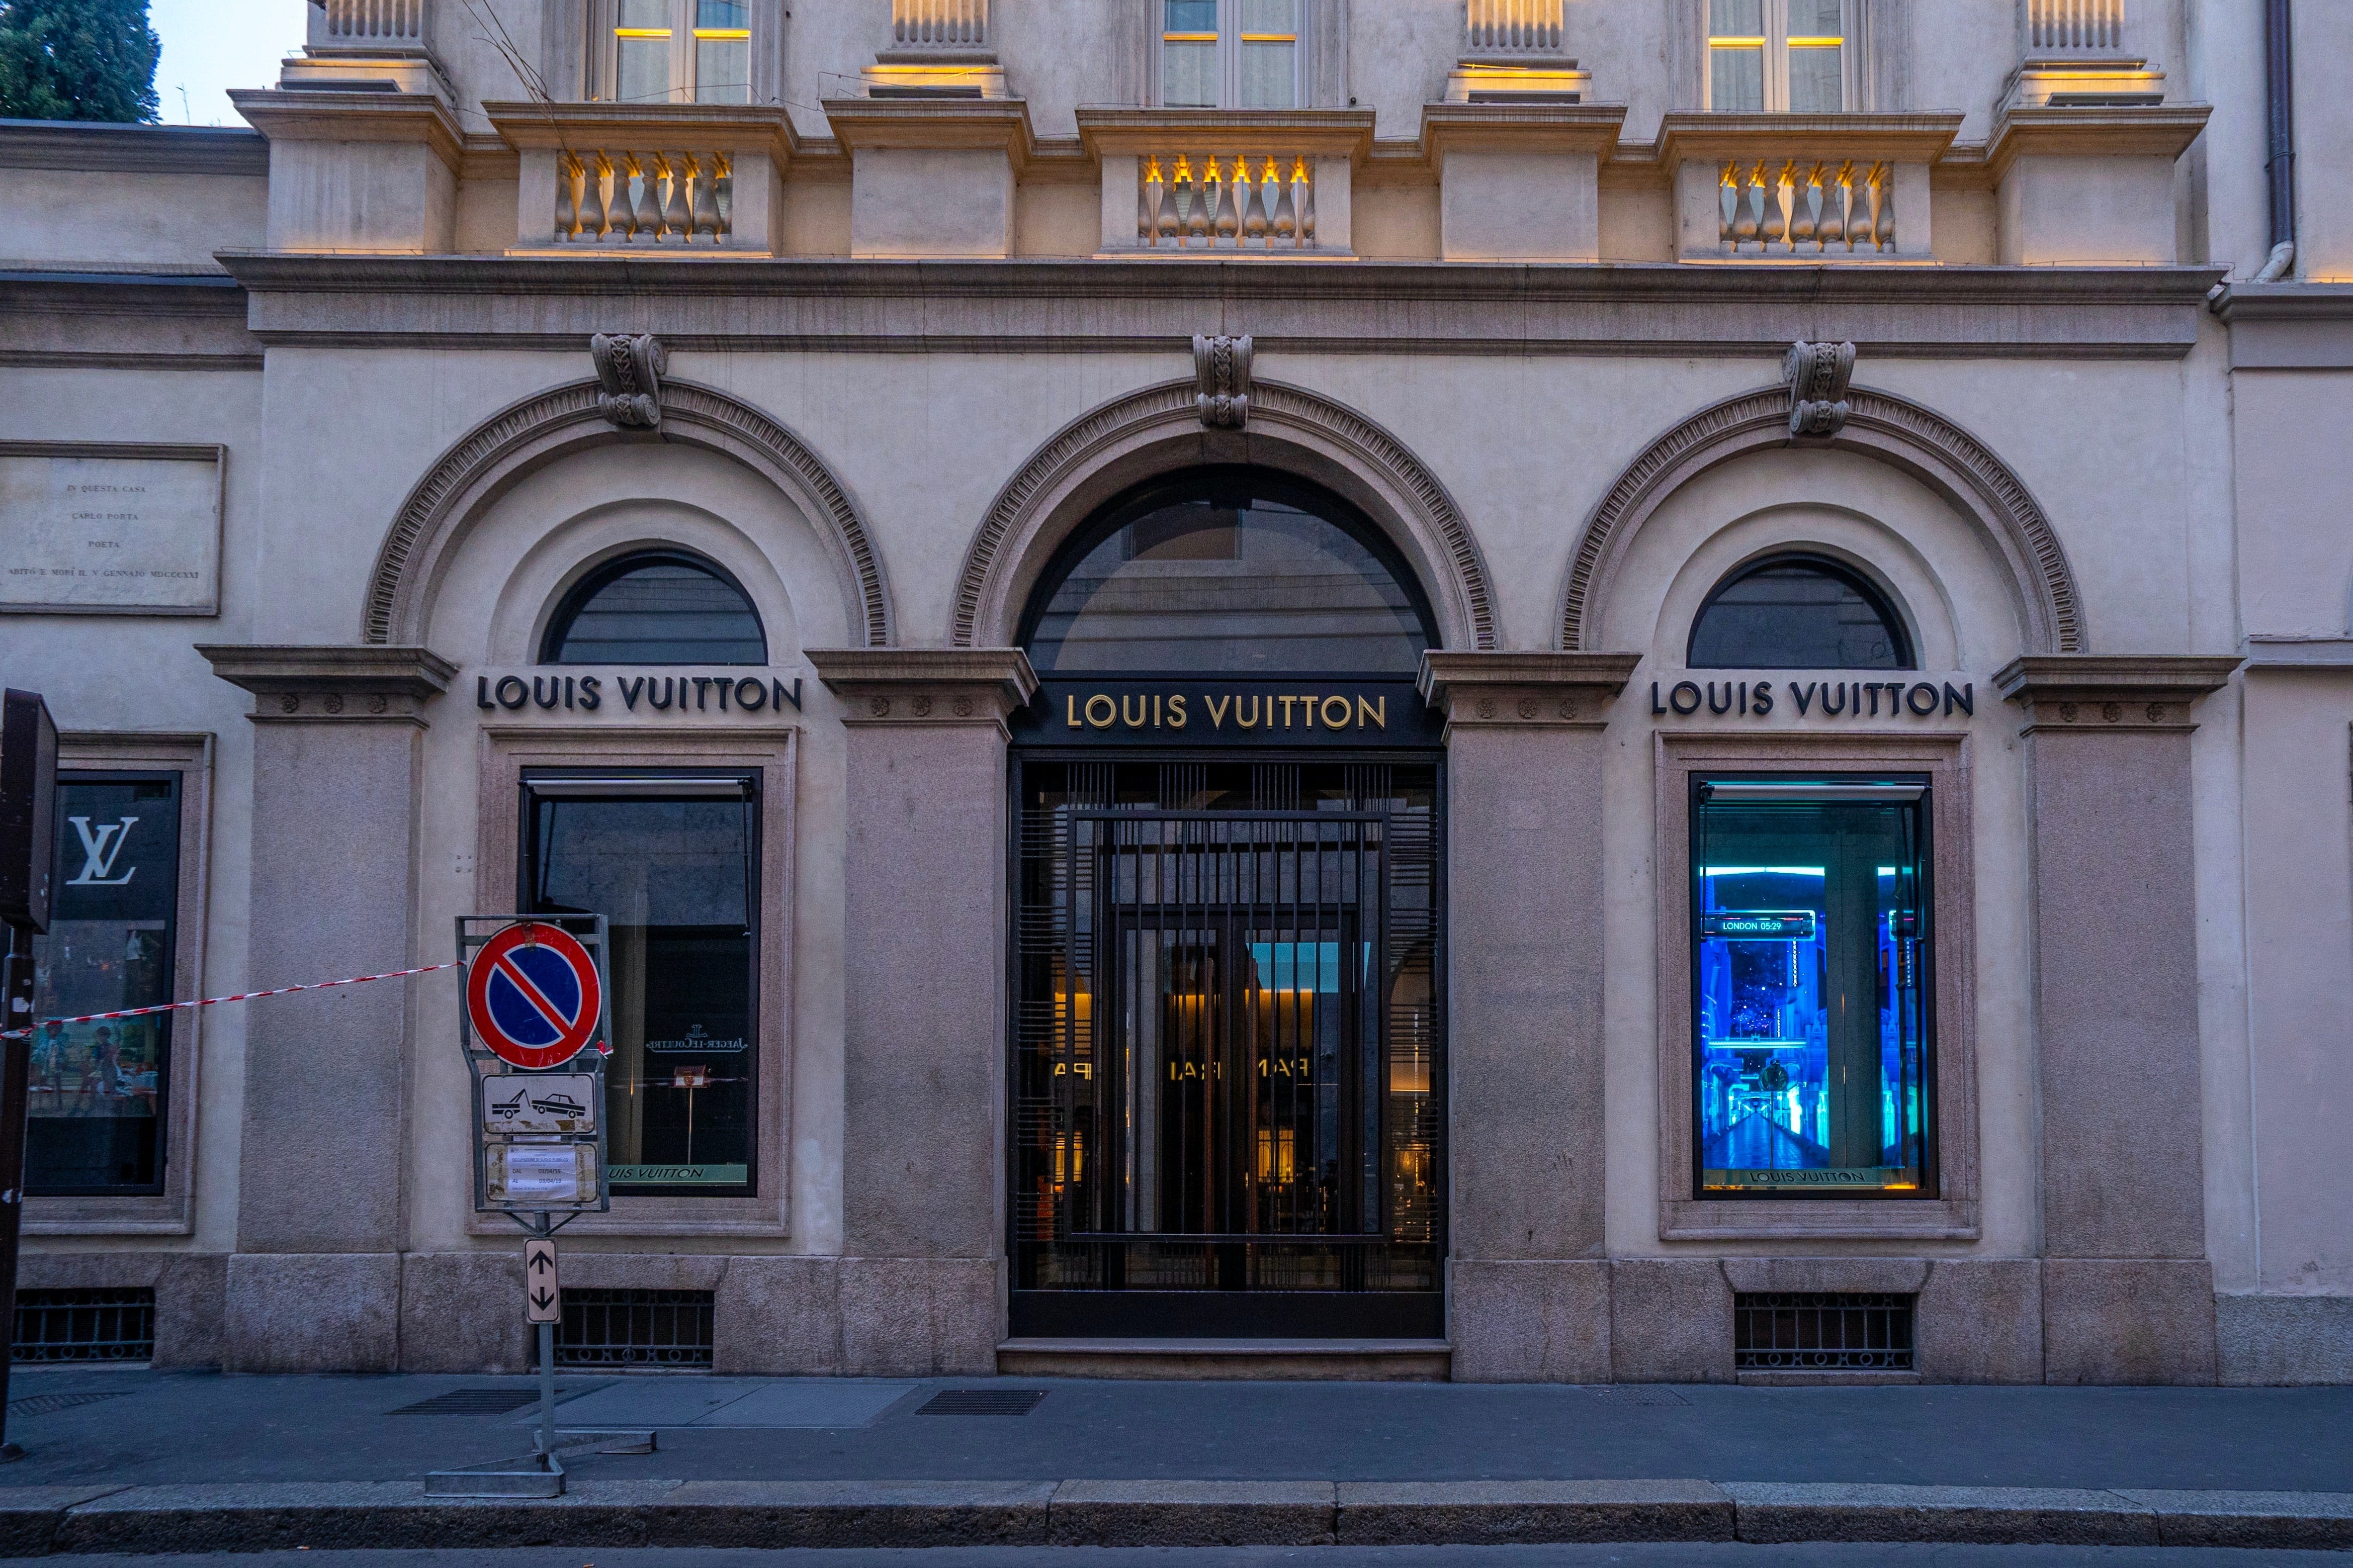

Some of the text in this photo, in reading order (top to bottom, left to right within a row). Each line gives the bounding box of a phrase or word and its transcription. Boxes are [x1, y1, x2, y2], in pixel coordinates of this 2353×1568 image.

[477, 676, 802, 712] LOUIS VUITTON
[1067, 694, 1385, 729] LOUIS VUITTON
[1651, 681, 1973, 716] LOUIS VUITTON
[608, 1169, 704, 1178] UIS VUITTON
[1750, 1172, 1865, 1182] LOUIS VUITTON
